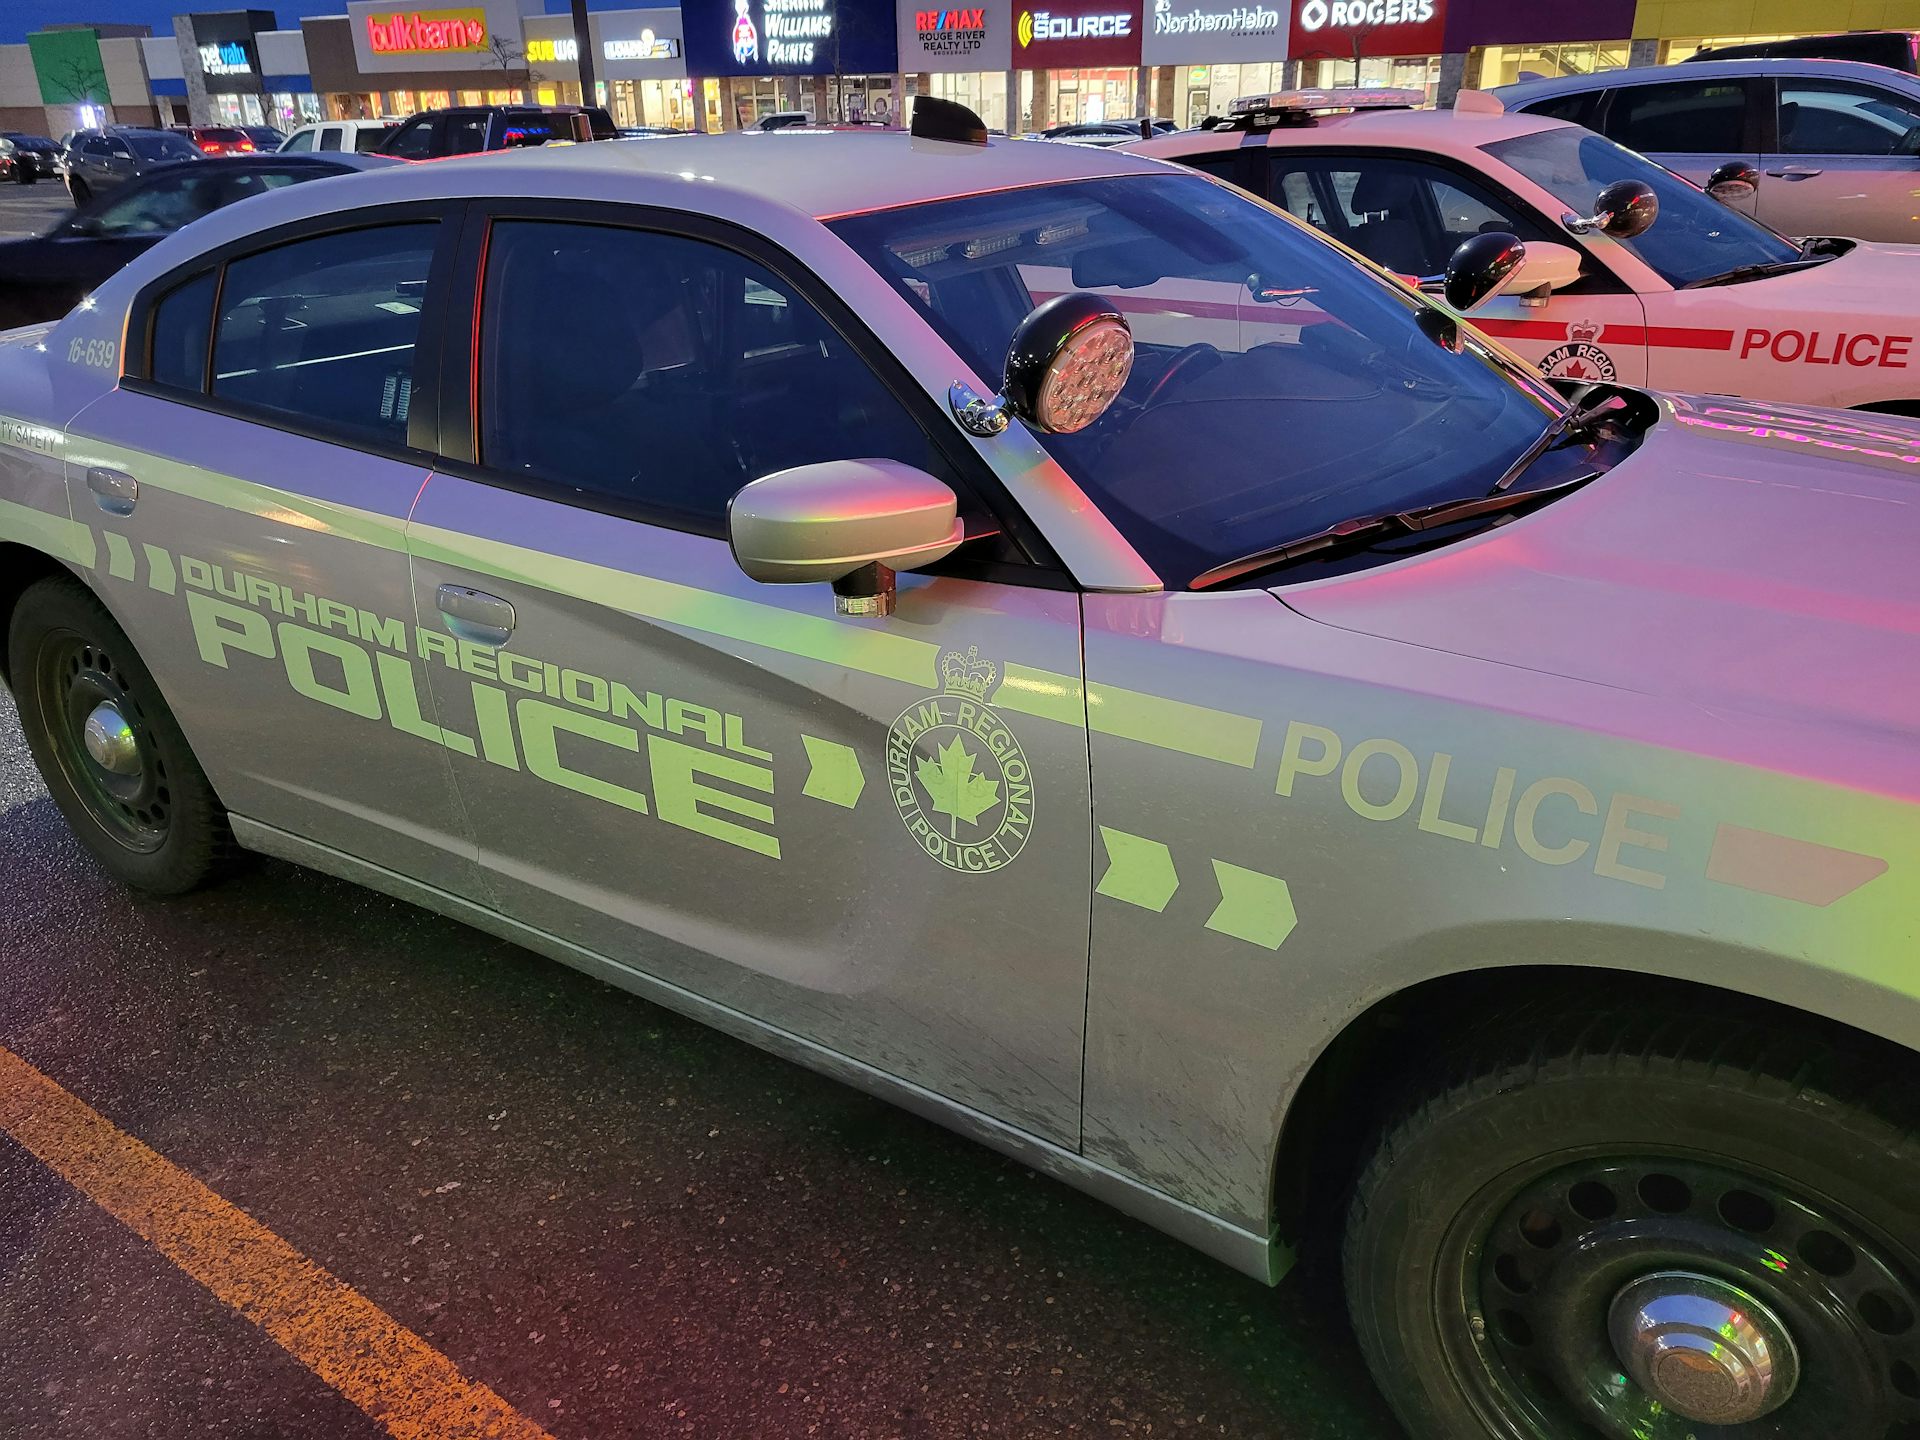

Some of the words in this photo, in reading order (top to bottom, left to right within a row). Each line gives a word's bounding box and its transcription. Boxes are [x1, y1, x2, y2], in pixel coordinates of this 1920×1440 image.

[764, 13, 832, 38] WILLIAMS
[915, 8, 985, 31] RE/MAX
[1034, 12, 1050, 20] THE
[1330, 0, 1433, 26] ROGERS
[367, 14, 415, 51] bulk
[413, 12, 468, 49] barn
[919, 32, 953, 41] ROUGE
[956, 31, 985, 40] RIVER
[1034, 15, 1132, 38] SOURCE
[527, 39, 578, 62] SUBWA
[766, 39, 814, 64] PAINTS
[924, 41, 960, 51] REALTY
[963, 40, 981, 49] LTD
[67, 337, 115, 368] 16-639
[1740, 328, 1913, 369] POLICE
[1540, 346, 1570, 376] HAM
[1577, 345, 1615, 381] REGION
[2, 420, 14, 441] TY
[180, 554, 407, 653] DURHAM
[416, 625, 774, 762] REGIONAL
[184, 589, 782, 861] POLICE
[890, 701, 943, 807] DURHAM
[957, 702, 1031, 840] REGIONAL
[1275, 720, 1682, 890] POLICE
[910, 818, 1001, 871] POLICE
